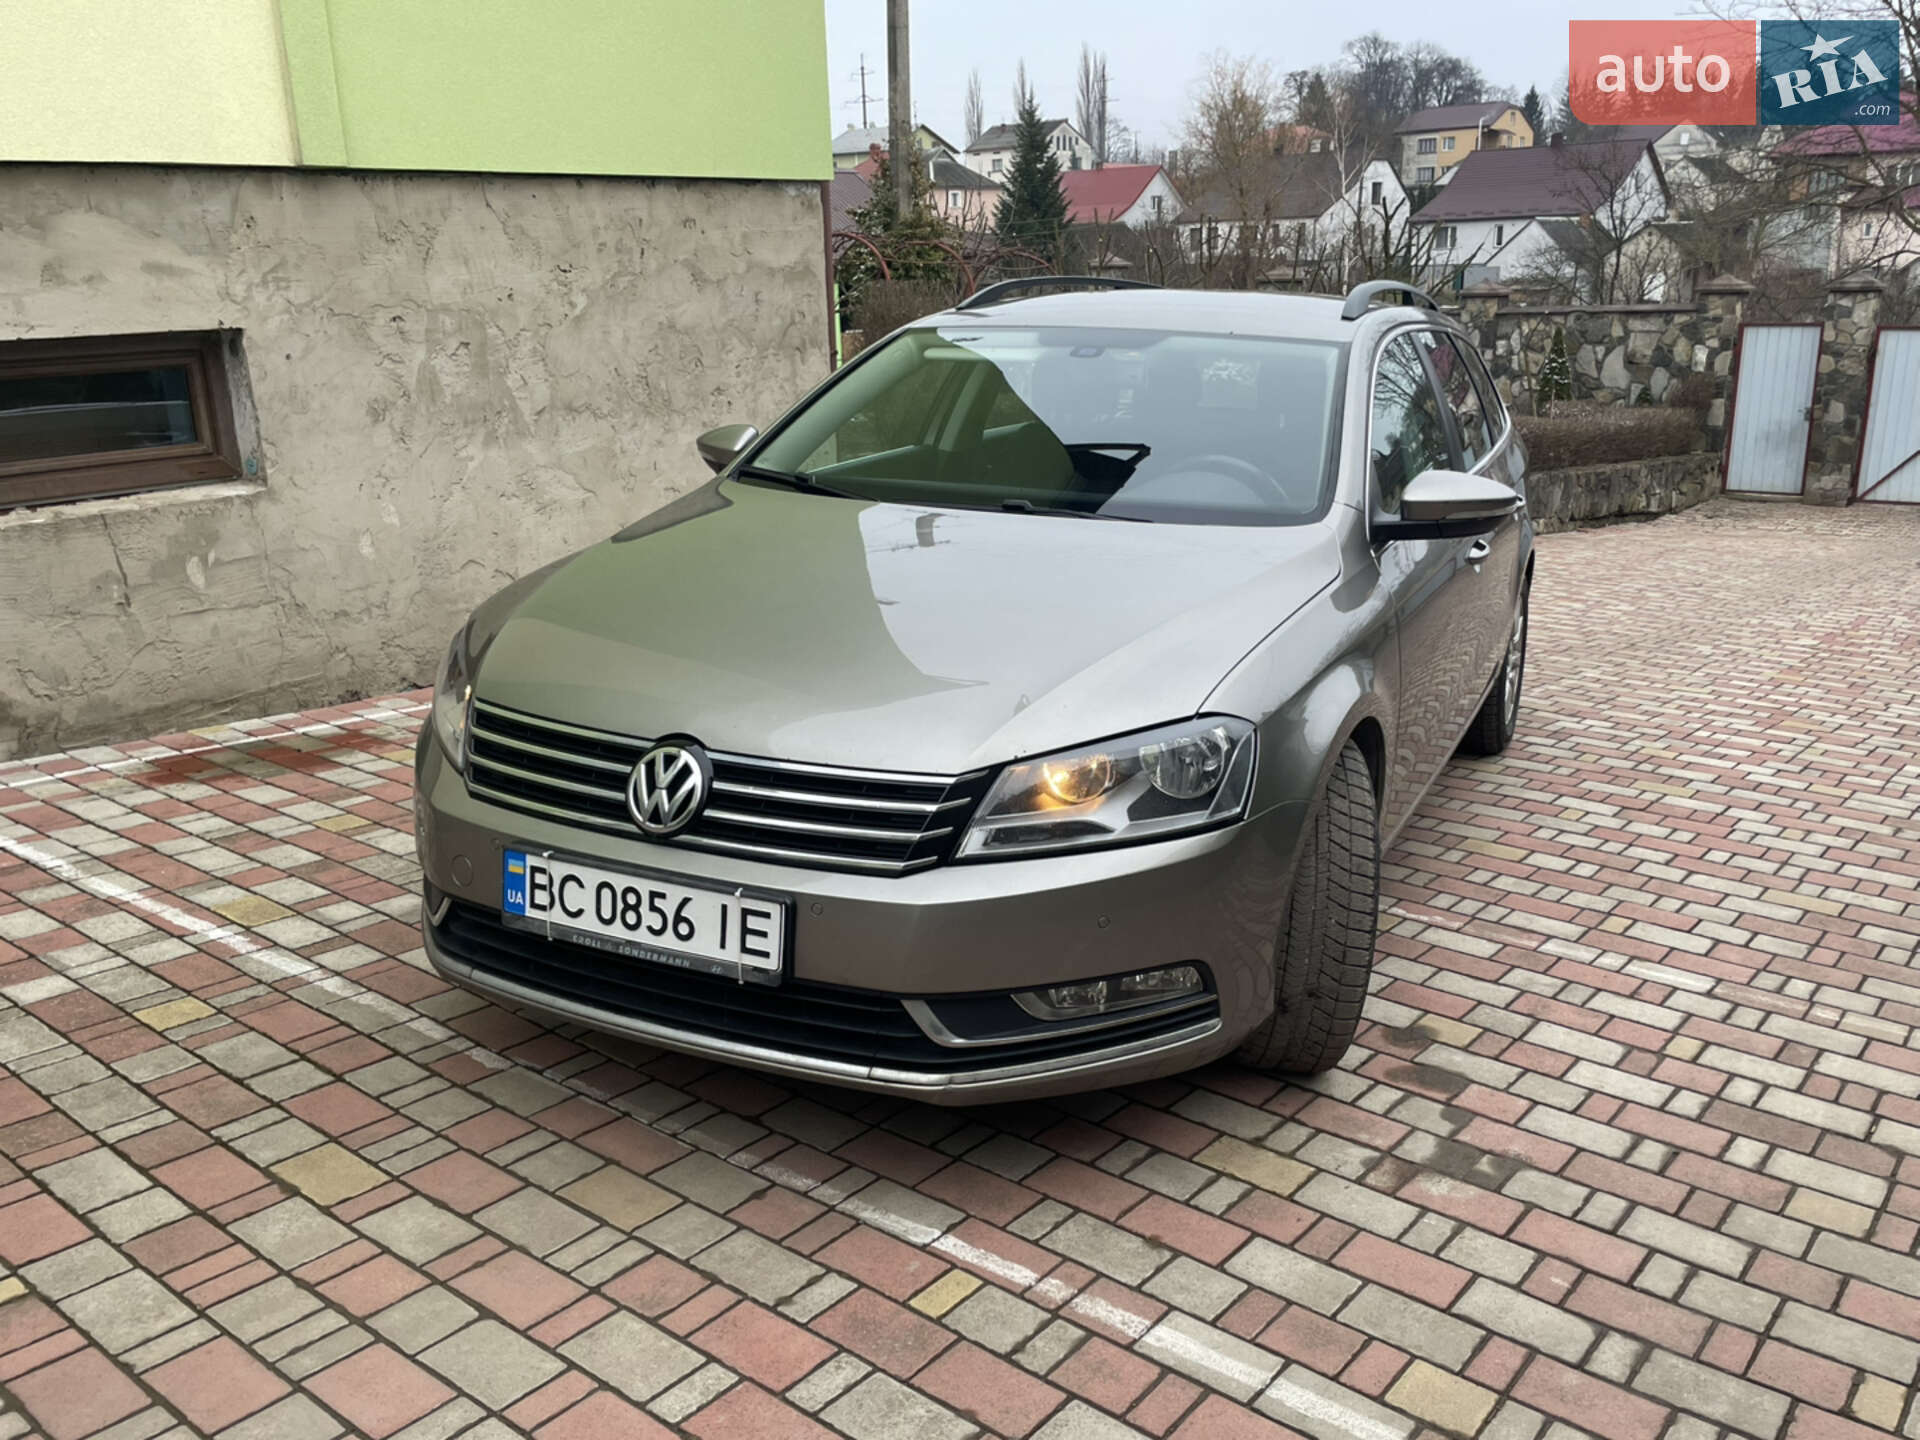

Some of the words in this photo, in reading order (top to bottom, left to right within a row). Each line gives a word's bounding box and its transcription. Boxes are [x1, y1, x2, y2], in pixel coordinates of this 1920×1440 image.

[507, 889, 524, 905] UA
[528, 865, 586, 919] BC
[595, 881, 695, 942] 0856
[719, 903, 772, 959] IE
